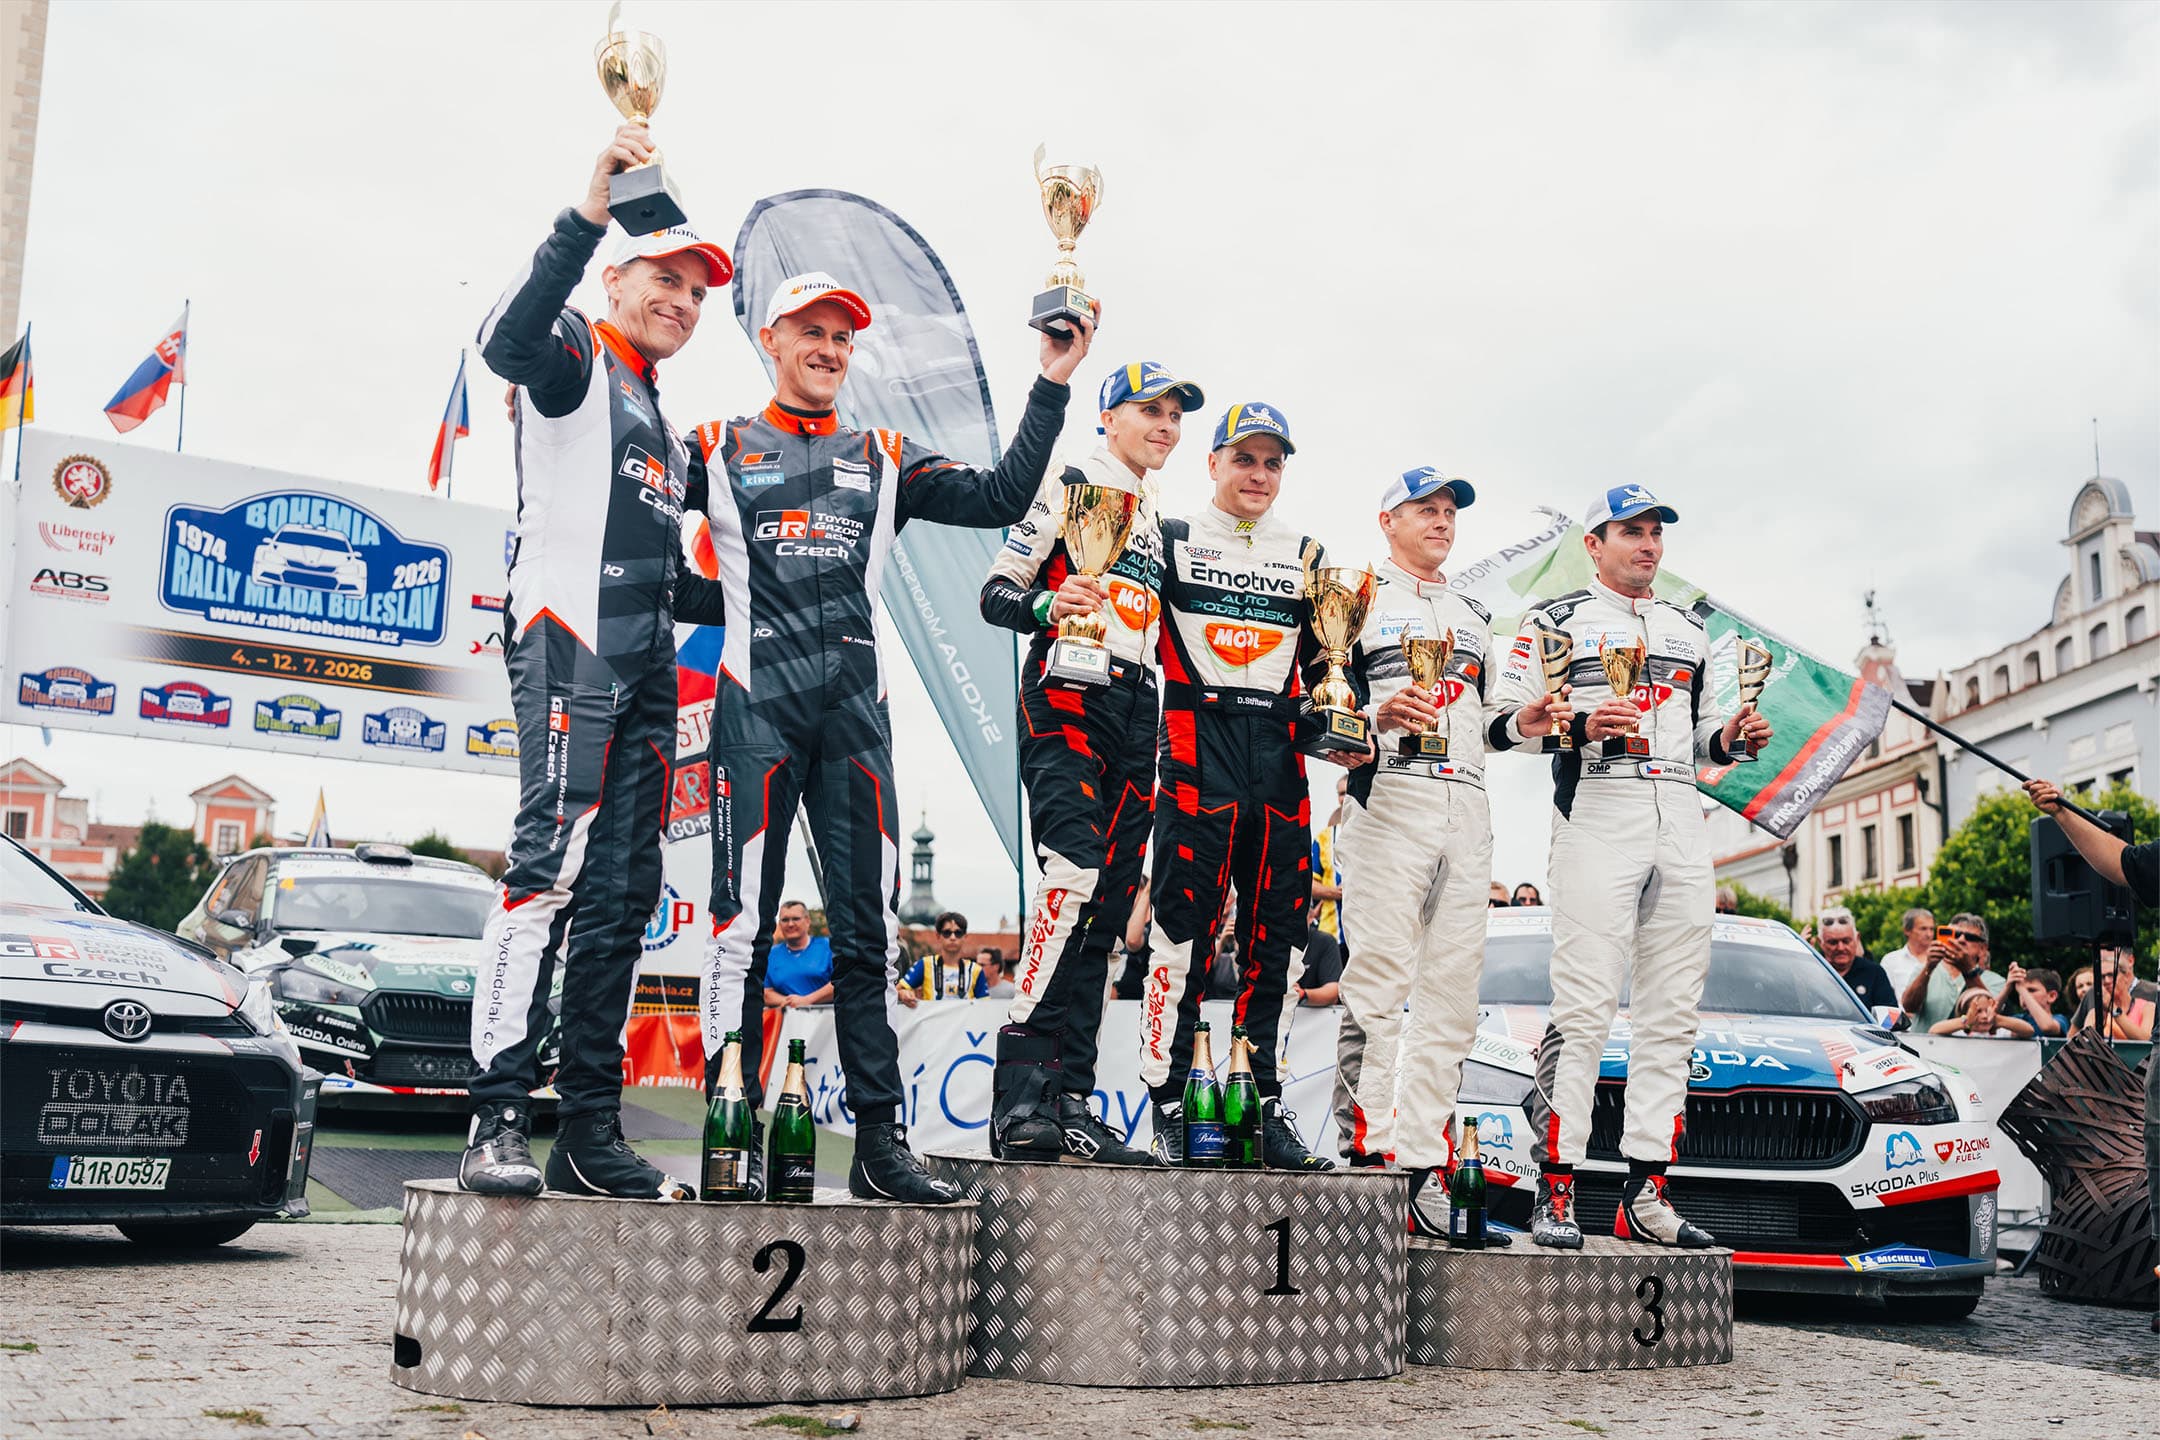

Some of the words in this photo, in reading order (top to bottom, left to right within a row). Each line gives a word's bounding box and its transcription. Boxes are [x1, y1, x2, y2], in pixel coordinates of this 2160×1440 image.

[1238, 420, 1284, 433] MICHELIN
[623, 458, 664, 492] GR
[246, 497, 381, 546] BOHEMIA
[757, 521, 807, 539] GR
[813, 522, 860, 538] GAZOO
[815, 512, 864, 531] TOYOTA
[78, 540, 103, 556] kraj
[176, 520, 227, 563] 1974
[776, 542, 849, 560] Czech
[811, 529, 857, 548] Racing
[33, 568, 112, 592] ABS
[171, 545, 242, 603] RALLY
[329, 583, 440, 631] BOLESLAV
[392, 557, 442, 590] 2026
[1191, 561, 1295, 595] Emotive
[1221, 594, 1269, 607] AUTO
[210, 606, 400, 645] www.rallybohemia.cz
[1213, 628, 1261, 649] MOL
[231, 649, 251, 667] 4.
[272, 653, 298, 672] 12.
[303, 658, 319, 674] 7.
[324, 661, 373, 681] 2026
[550, 697, 563, 730] GR
[547, 731, 558, 783] Czech
[559, 733, 569, 776] TOYOTA
[1587, 763, 1611, 774] OMP
[557, 777, 568, 815] GAZOO
[717, 766, 725, 796] GR
[550, 815, 564, 851] Racing
[717, 797, 725, 841] Czech
[1021, 918, 1055, 996] RACING
[43, 963, 162, 985] Czech
[336, 1036, 366, 1052] Online
[48, 1067, 191, 1103] TOYOTA
[1955, 1137, 1990, 1153] RACING
[50, 1178, 64, 1188] CZ
[114, 1161, 168, 1185] 0597
[1919, 1170, 1940, 1186] Plus
[1264, 1217, 1306, 1295] 1
[1877, 1255, 1926, 1264] MICHELIN
[747, 1240, 805, 1332] 2
[1633, 1276, 1665, 1348] 3
